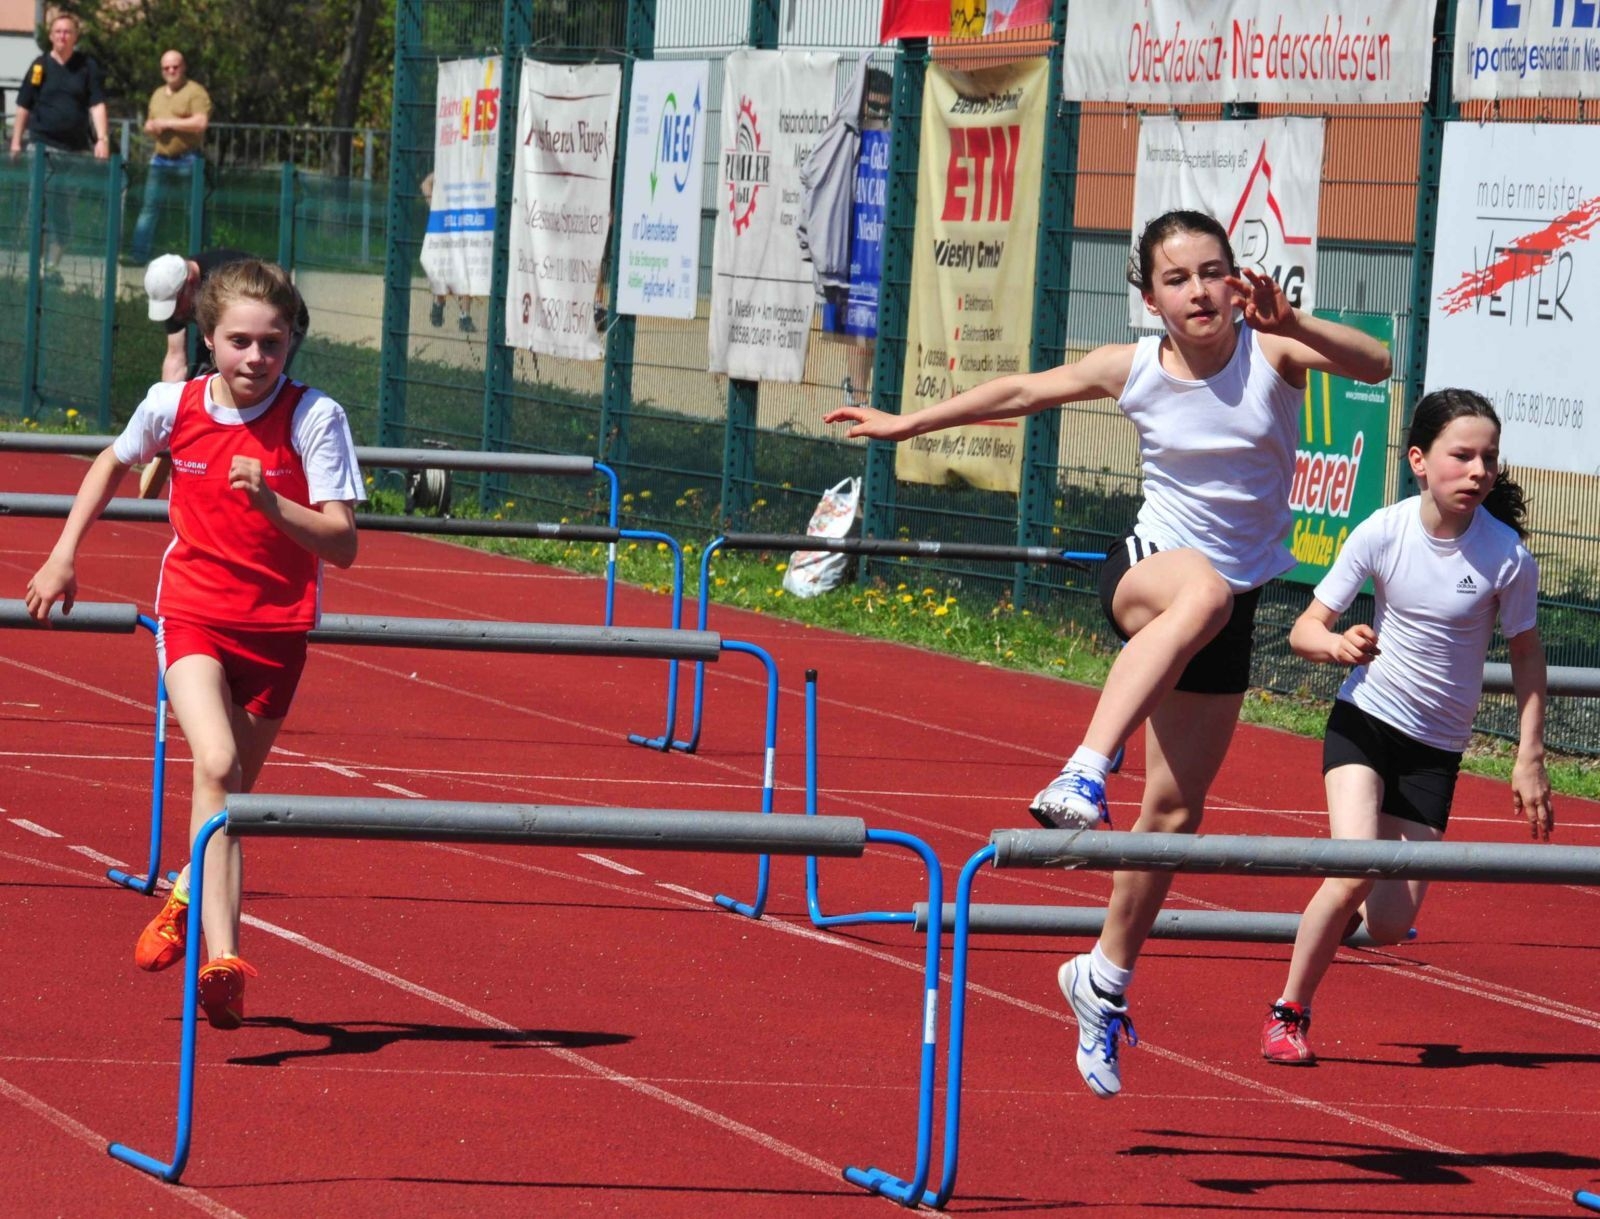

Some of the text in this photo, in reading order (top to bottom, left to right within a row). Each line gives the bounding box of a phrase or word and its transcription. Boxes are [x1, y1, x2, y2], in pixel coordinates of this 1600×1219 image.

[1583, 37, 1600, 73] Nie
[661, 114, 691, 163] NEG
[941, 125, 1021, 222] ETN
[1476, 175, 1583, 211] malermeister
[1474, 229, 1573, 328] VETTER
[1288, 431, 1364, 518] merei
[1291, 518, 1334, 567] Schulze
